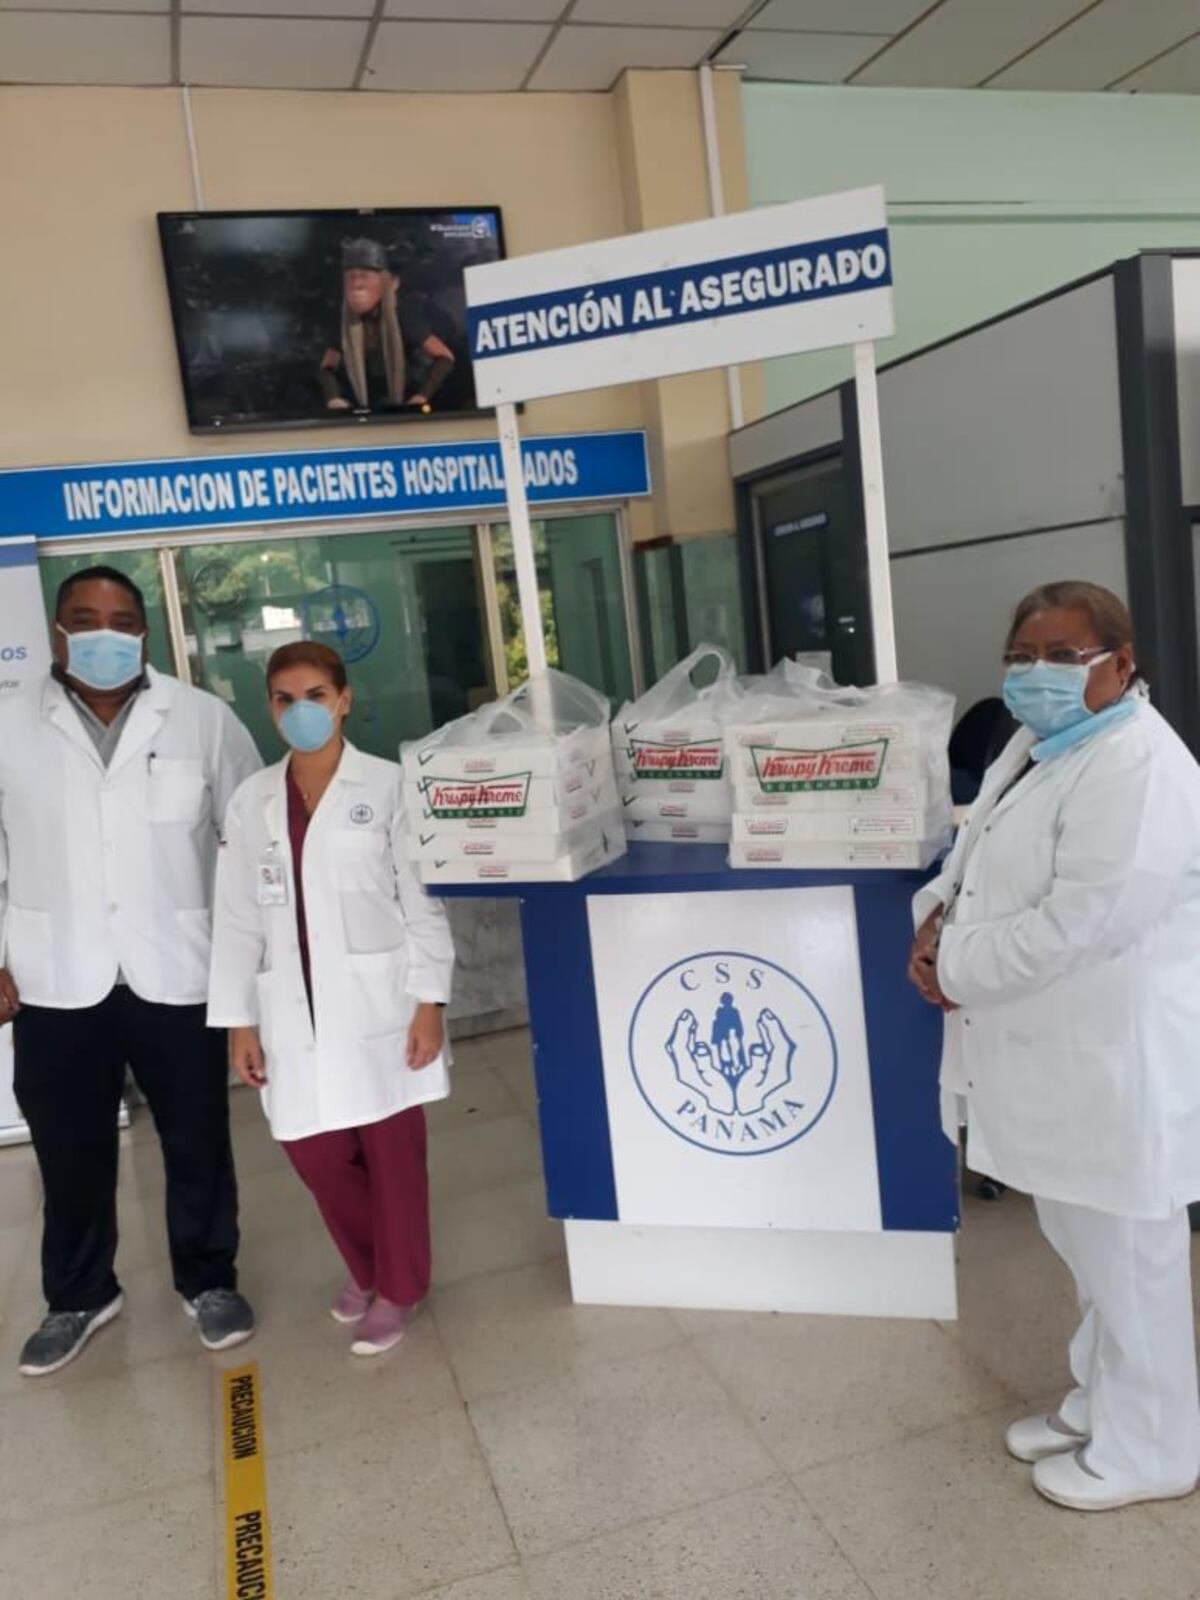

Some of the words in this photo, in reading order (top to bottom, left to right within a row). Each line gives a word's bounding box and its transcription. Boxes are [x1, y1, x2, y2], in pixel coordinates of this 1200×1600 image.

[476, 289, 624, 354] ATENCIÓN
[632, 286, 672, 324] AL
[679, 243, 887, 316] ASEGURADO
[62, 472, 236, 522] INFORMACION
[238, 469, 271, 508] DE
[272, 461, 398, 506] PACIENTES
[401, 448, 578, 495] HOSPITALADOS
[762, 755, 817, 779] Krispy
[817, 751, 877, 776] Kreme
[679, 962, 765, 991] CSS
[676, 1099, 805, 1142] PANAMA
[230, 1374, 258, 1460] PRECAUCION
